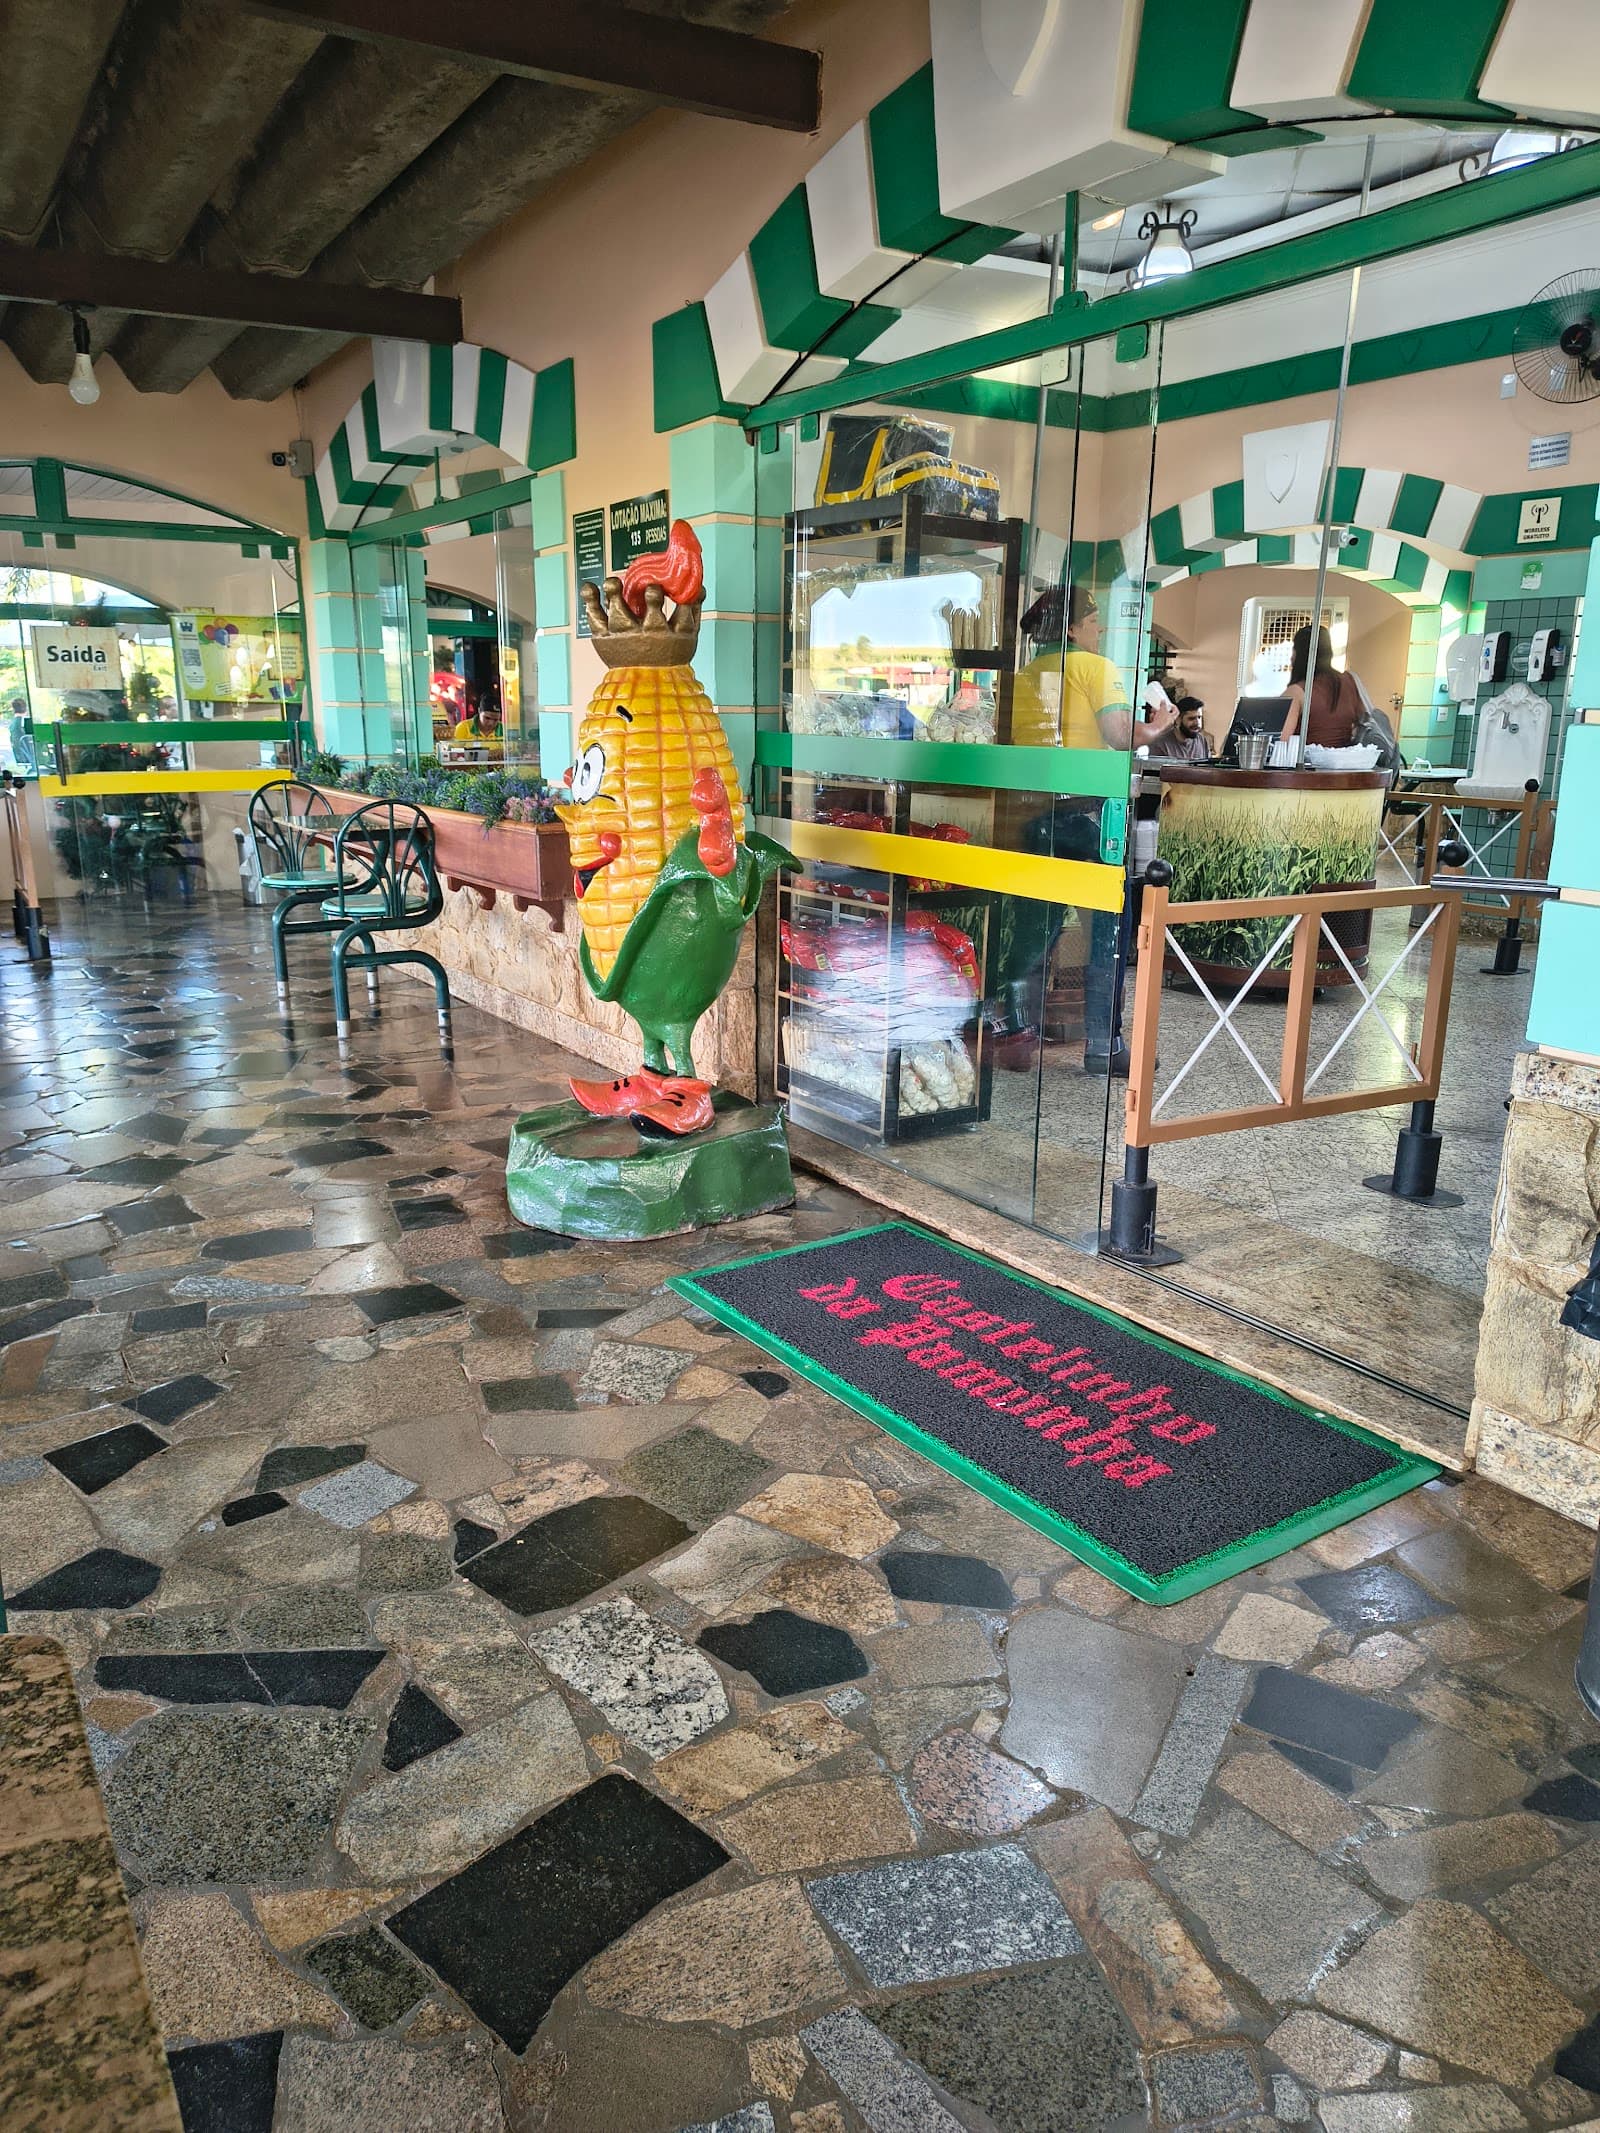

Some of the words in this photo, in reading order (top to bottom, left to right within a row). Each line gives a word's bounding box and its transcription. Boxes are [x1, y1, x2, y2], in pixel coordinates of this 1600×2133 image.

[611, 502, 639, 532] LOTAÇÃO
[630, 529, 642, 546] 135
[645, 525, 667, 544] PESSOAS
[882, 1274, 1217, 1445] Castelinho
